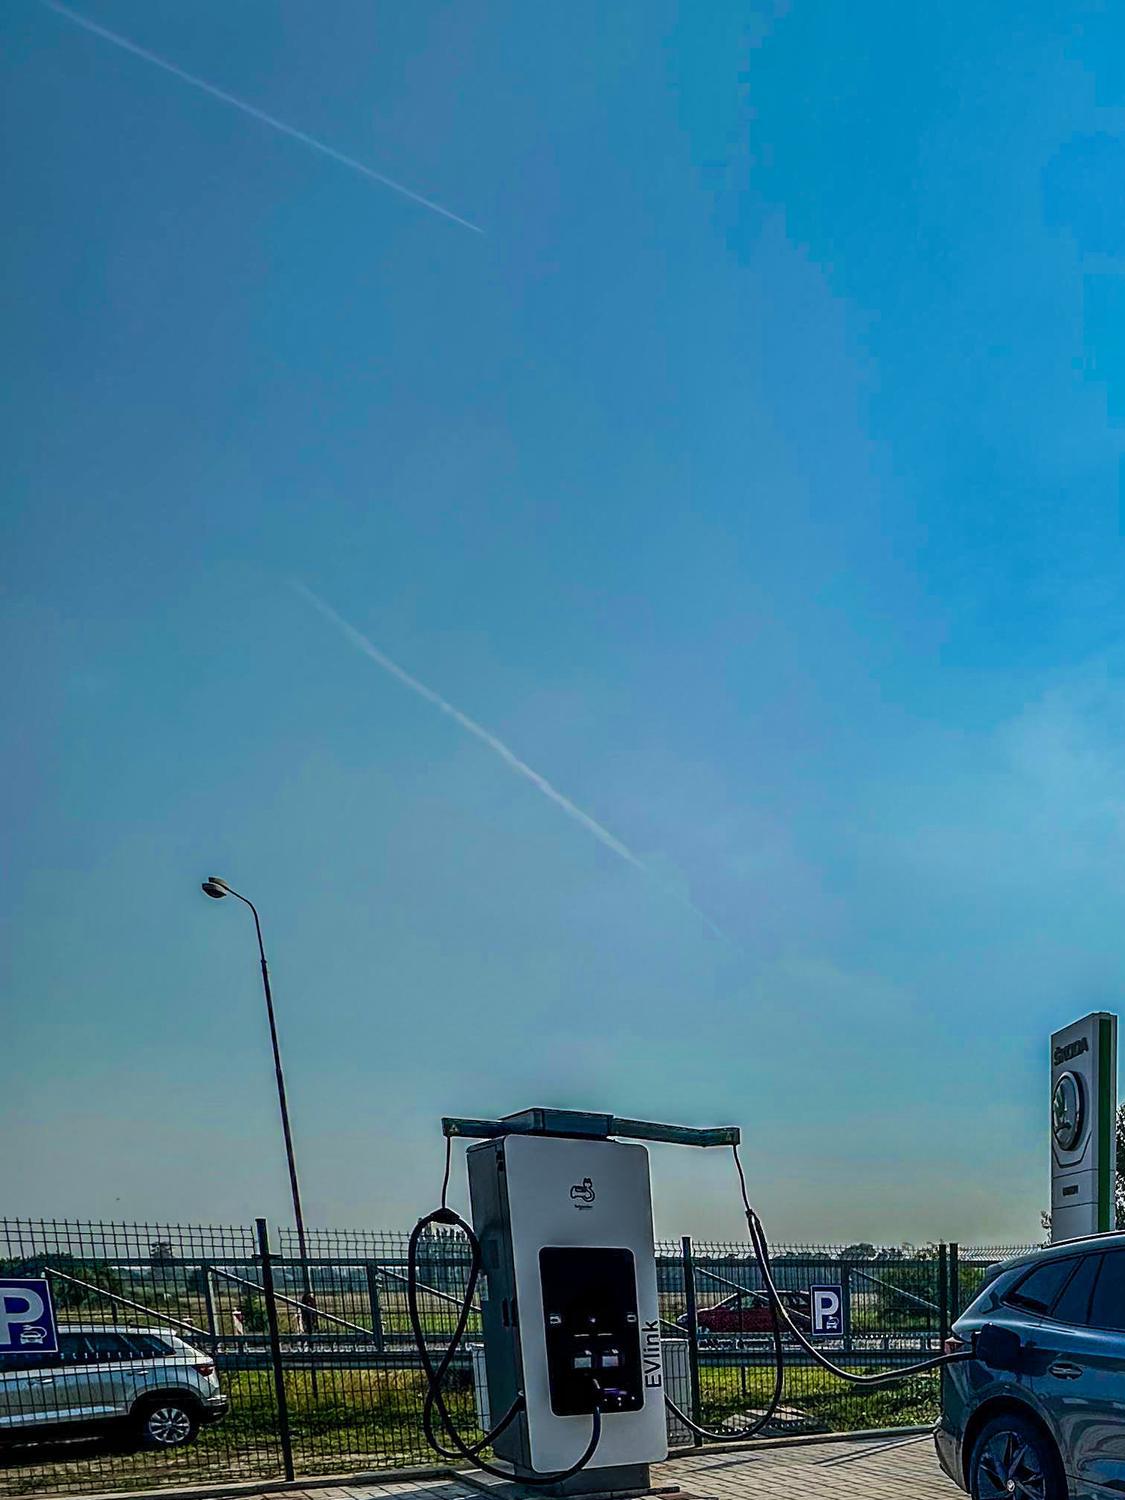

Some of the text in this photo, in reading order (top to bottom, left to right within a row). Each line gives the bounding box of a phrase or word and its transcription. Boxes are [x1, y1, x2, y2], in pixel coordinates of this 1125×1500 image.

[0, 1287, 44, 1345] P
[814, 1291, 839, 1330] P
[641, 1320, 662, 1388] EVlink
